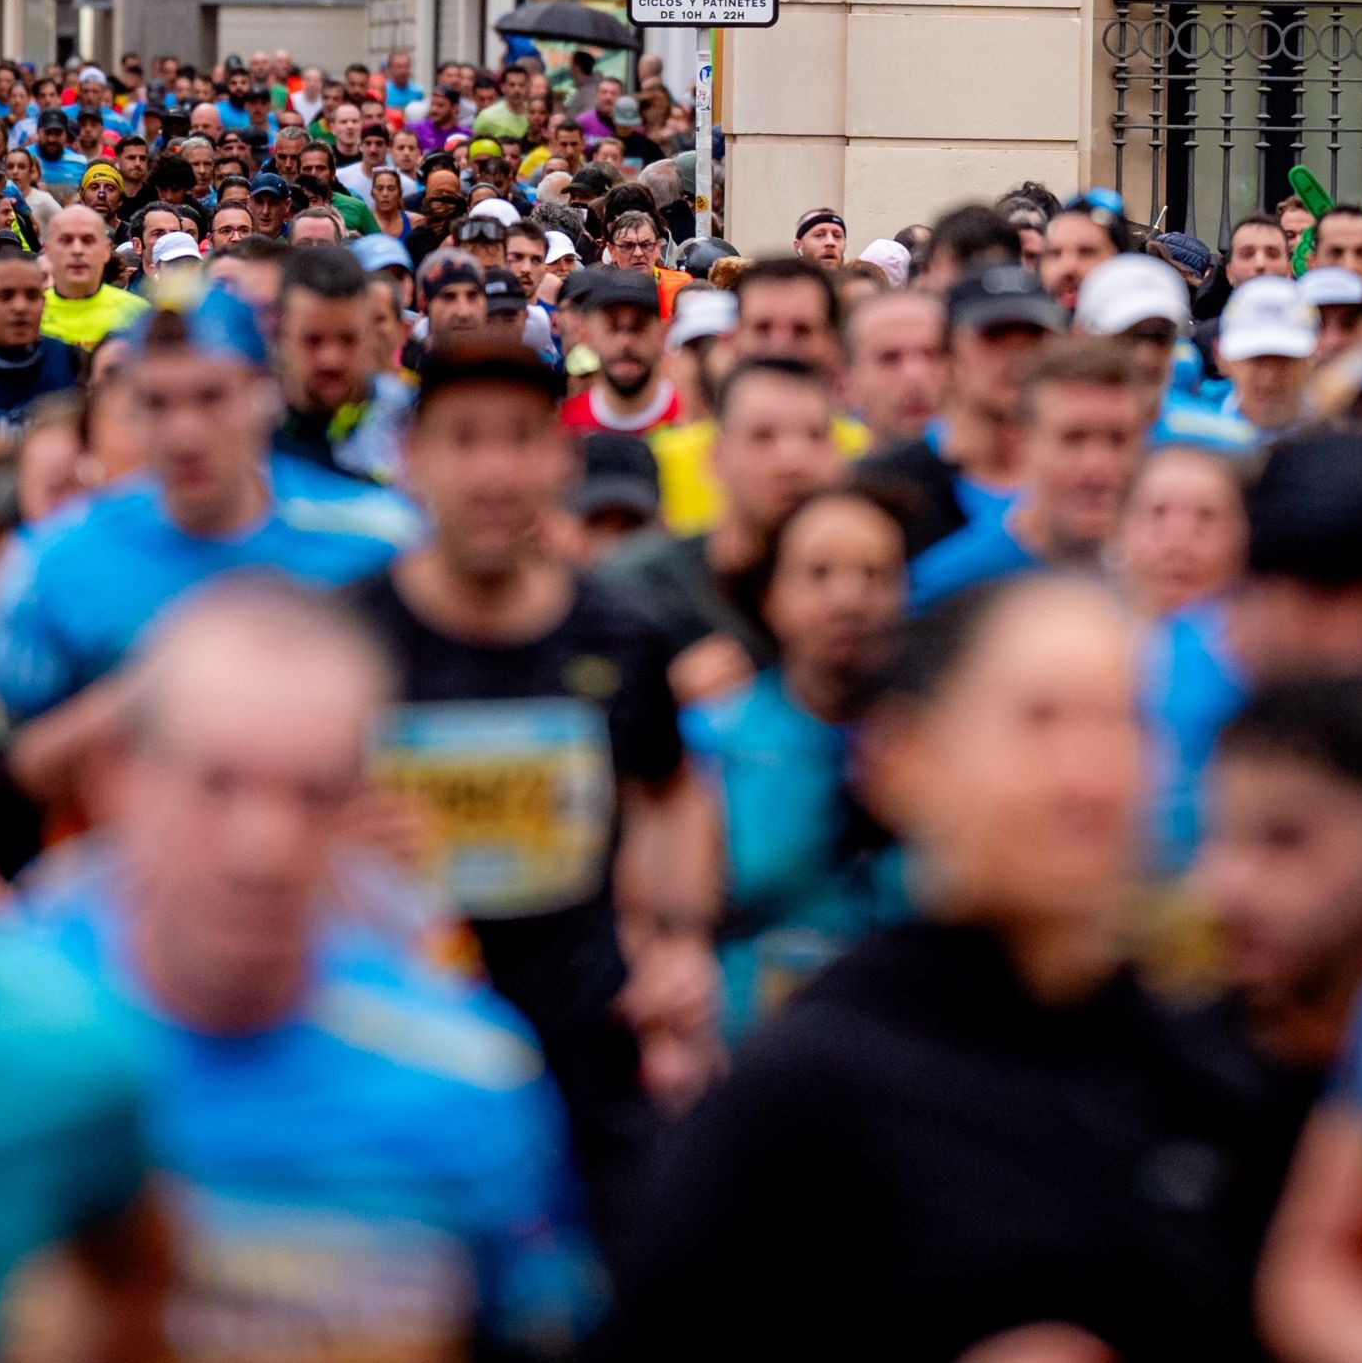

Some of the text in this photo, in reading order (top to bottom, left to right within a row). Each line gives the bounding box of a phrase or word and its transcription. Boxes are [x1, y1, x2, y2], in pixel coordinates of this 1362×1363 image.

[660, 11, 745, 20] DE 10H A 22H
